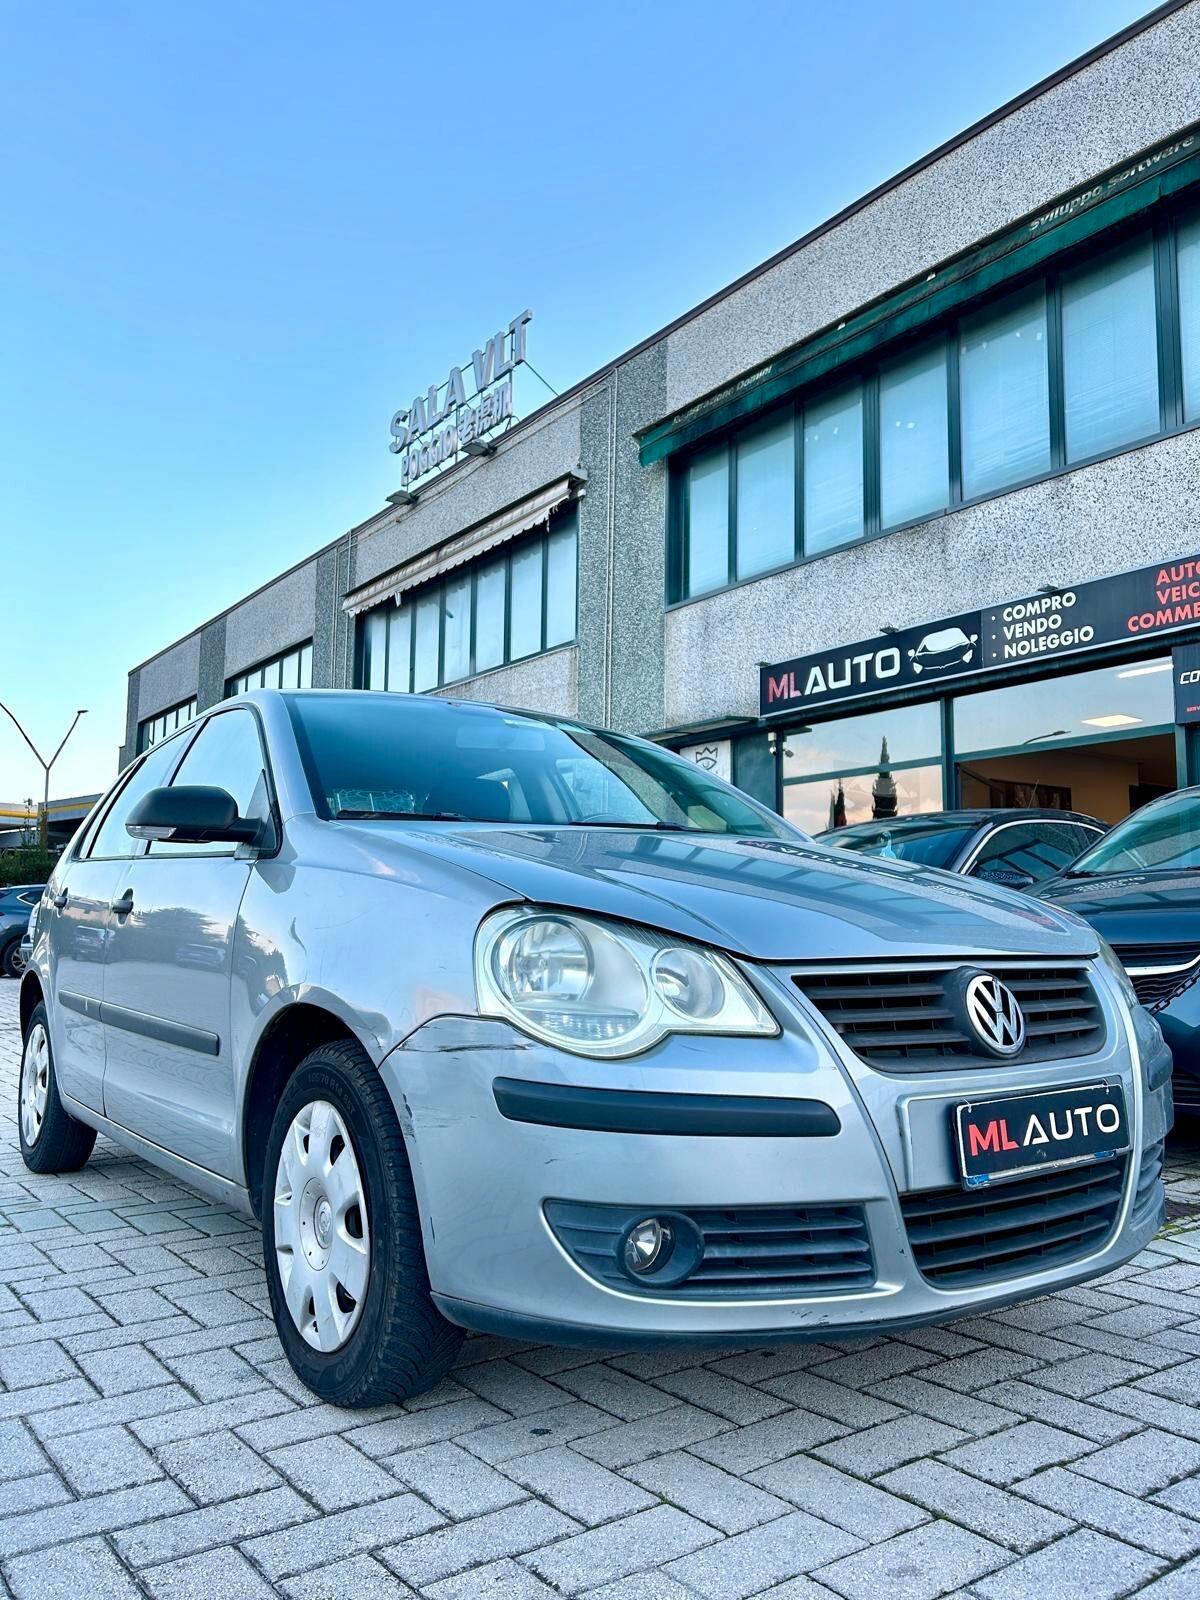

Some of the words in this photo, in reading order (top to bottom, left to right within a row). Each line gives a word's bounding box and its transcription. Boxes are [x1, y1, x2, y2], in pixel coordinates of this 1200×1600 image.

[389, 366, 467, 454] SALA
[472, 309, 532, 393] VLT
[401, 425, 458, 487] POGGIO
[1156, 561, 1200, 586] AUT
[1156, 581, 1200, 605] VEIC
[1003, 592, 1077, 622] COMPRO
[1003, 614, 1063, 641] VENDO
[1003, 625, 1095, 660] NOLEGGIO
[768, 672, 802, 703] ML
[804, 647, 900, 695] AUTO
[967, 974, 1025, 1054] VW
[968, 1119, 1020, 1156] ML
[1023, 1103, 1120, 1147] AUTO
